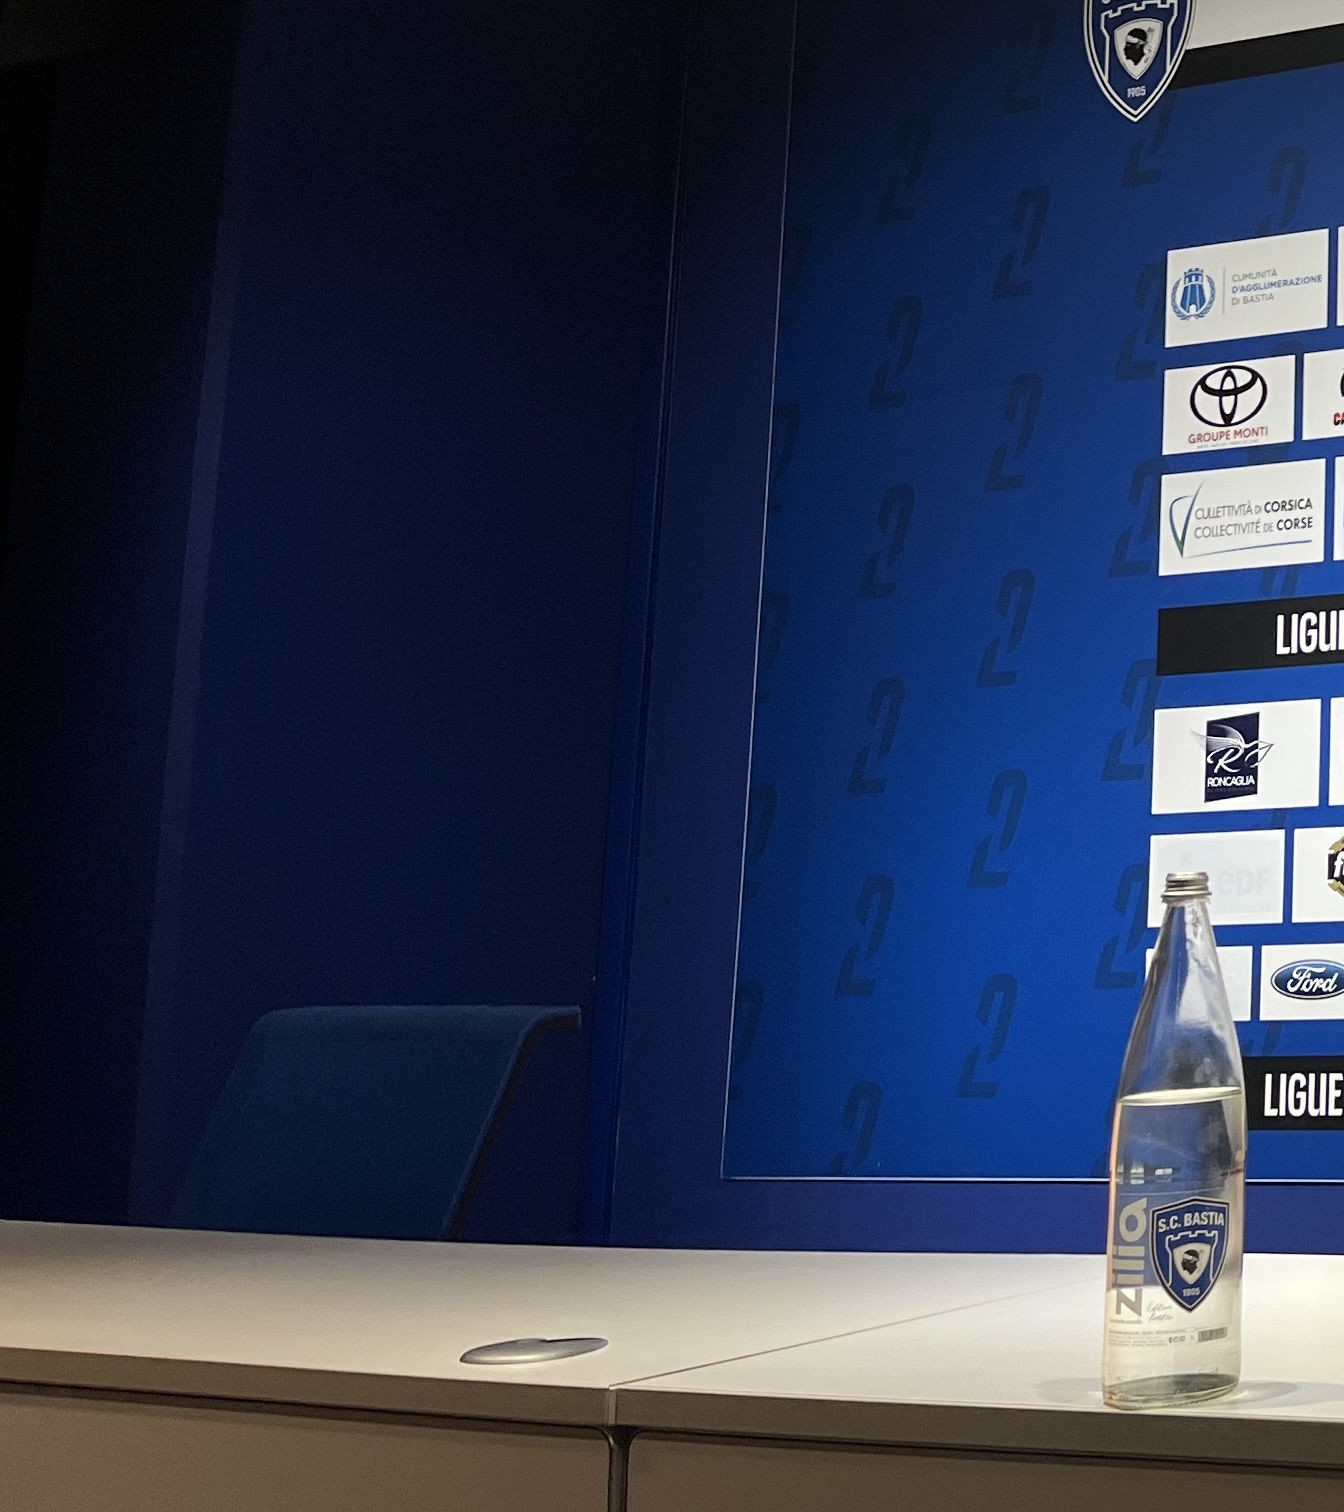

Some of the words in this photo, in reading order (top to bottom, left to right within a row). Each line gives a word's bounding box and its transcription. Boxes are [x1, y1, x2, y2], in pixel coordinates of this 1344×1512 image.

[1188, 431, 1231, 445] GROUPE
[1233, 427, 1269, 440] MONTI
[1264, 498, 1313, 513] CORSICA
[1276, 517, 1313, 530] CORSE
[1207, 774, 1255, 788] RONCAGLIA
[1287, 965, 1338, 993] Ford
[1264, 1073, 1342, 1117] LIGUE
[1158, 1216, 1181, 1233] S.C.
[1184, 1211, 1225, 1227] BASTIA
